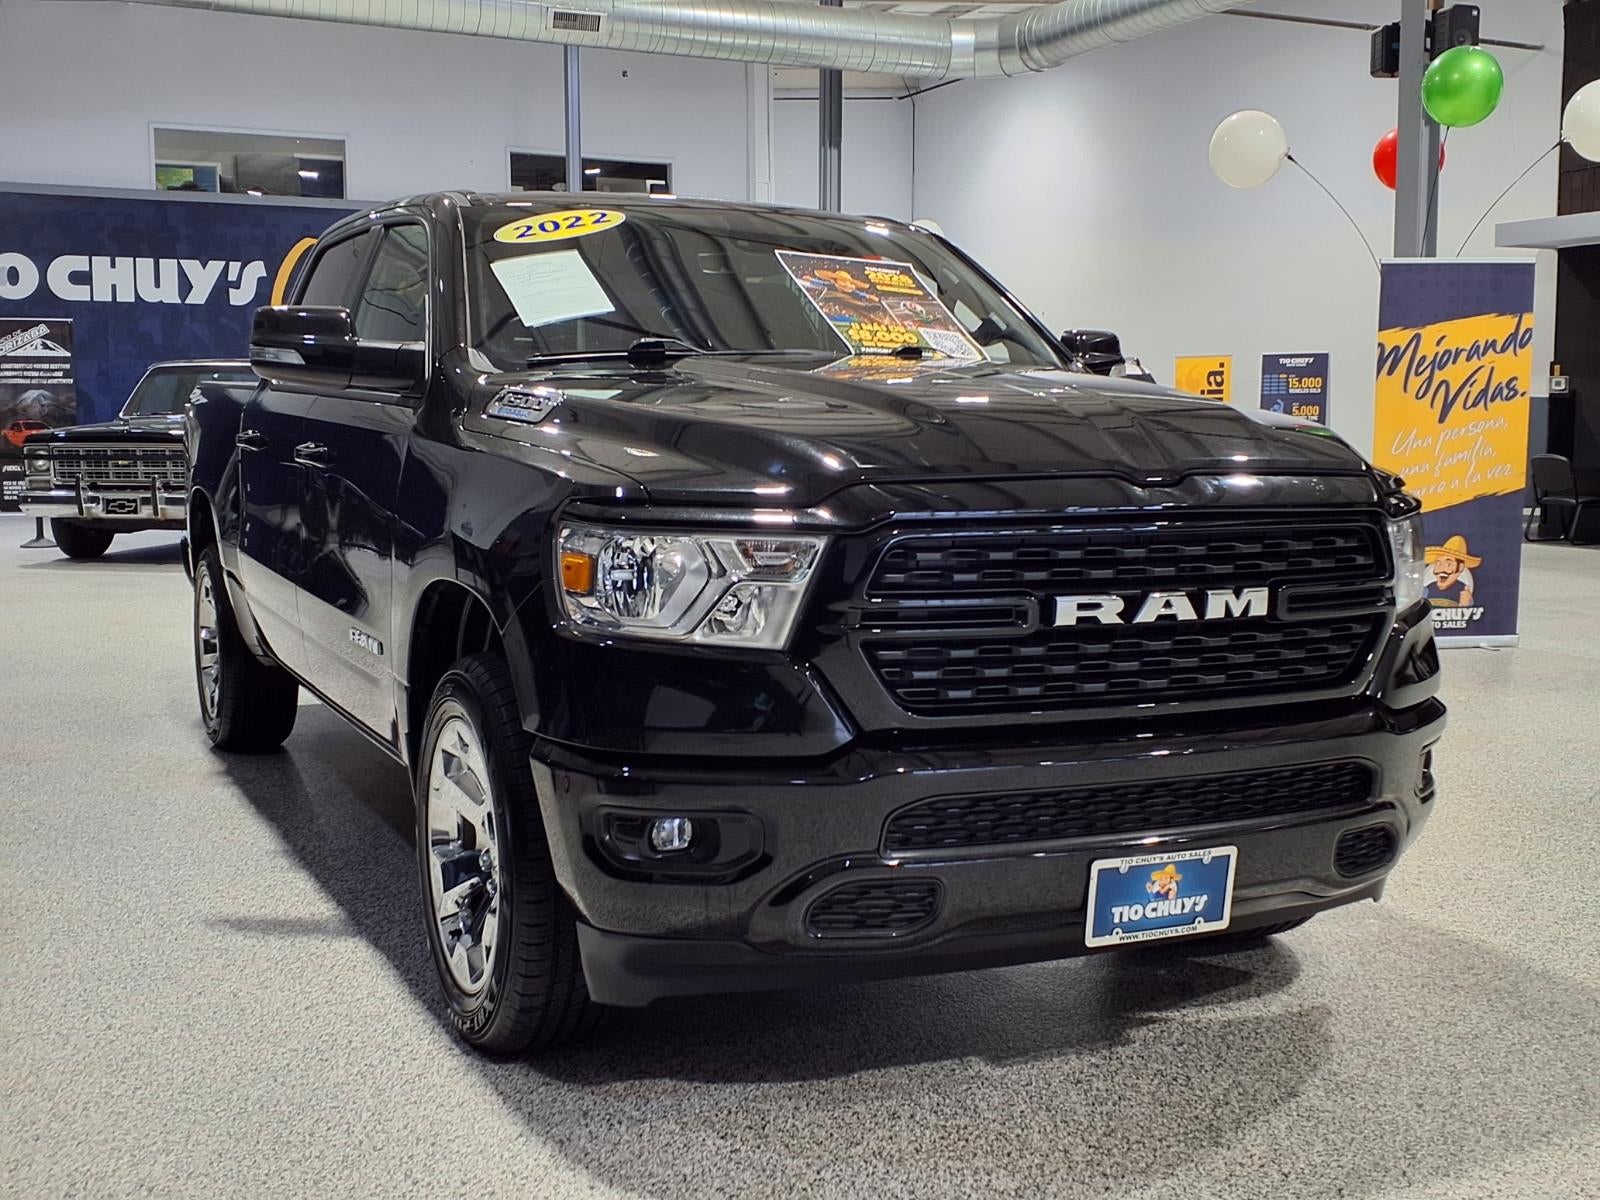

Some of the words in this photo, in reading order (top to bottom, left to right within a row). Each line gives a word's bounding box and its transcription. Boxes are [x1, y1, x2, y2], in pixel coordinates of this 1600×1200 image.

[513, 212, 611, 239] 2022
[0, 253, 39, 300] O
[47, 254, 267, 306] CHUY'S
[1376, 312, 1533, 400] Mejorando
[1200, 362, 1225, 402] ia.
[1430, 364, 1528, 424] Vidas.
[1392, 428, 1432, 457] Una
[1435, 416, 1509, 456] persona,
[1399, 464, 1429, 477] una
[1434, 436, 1496, 477] familia,
[1465, 462, 1481, 489] la
[1052, 586, 1269, 627] RAM
[1432, 607, 1484, 620] CHUY'S
[1442, 621, 1467, 629] SALES
[1135, 855, 1165, 864] CHUY'S
[1166, 852, 1188, 861] AUTO
[1188, 849, 1212, 859] SALES
[1111, 904, 1144, 925] TIO
[1144, 895, 1208, 919] CHUY'S
[1119, 925, 1198, 942] WWW.TIOCHUYS.COM
